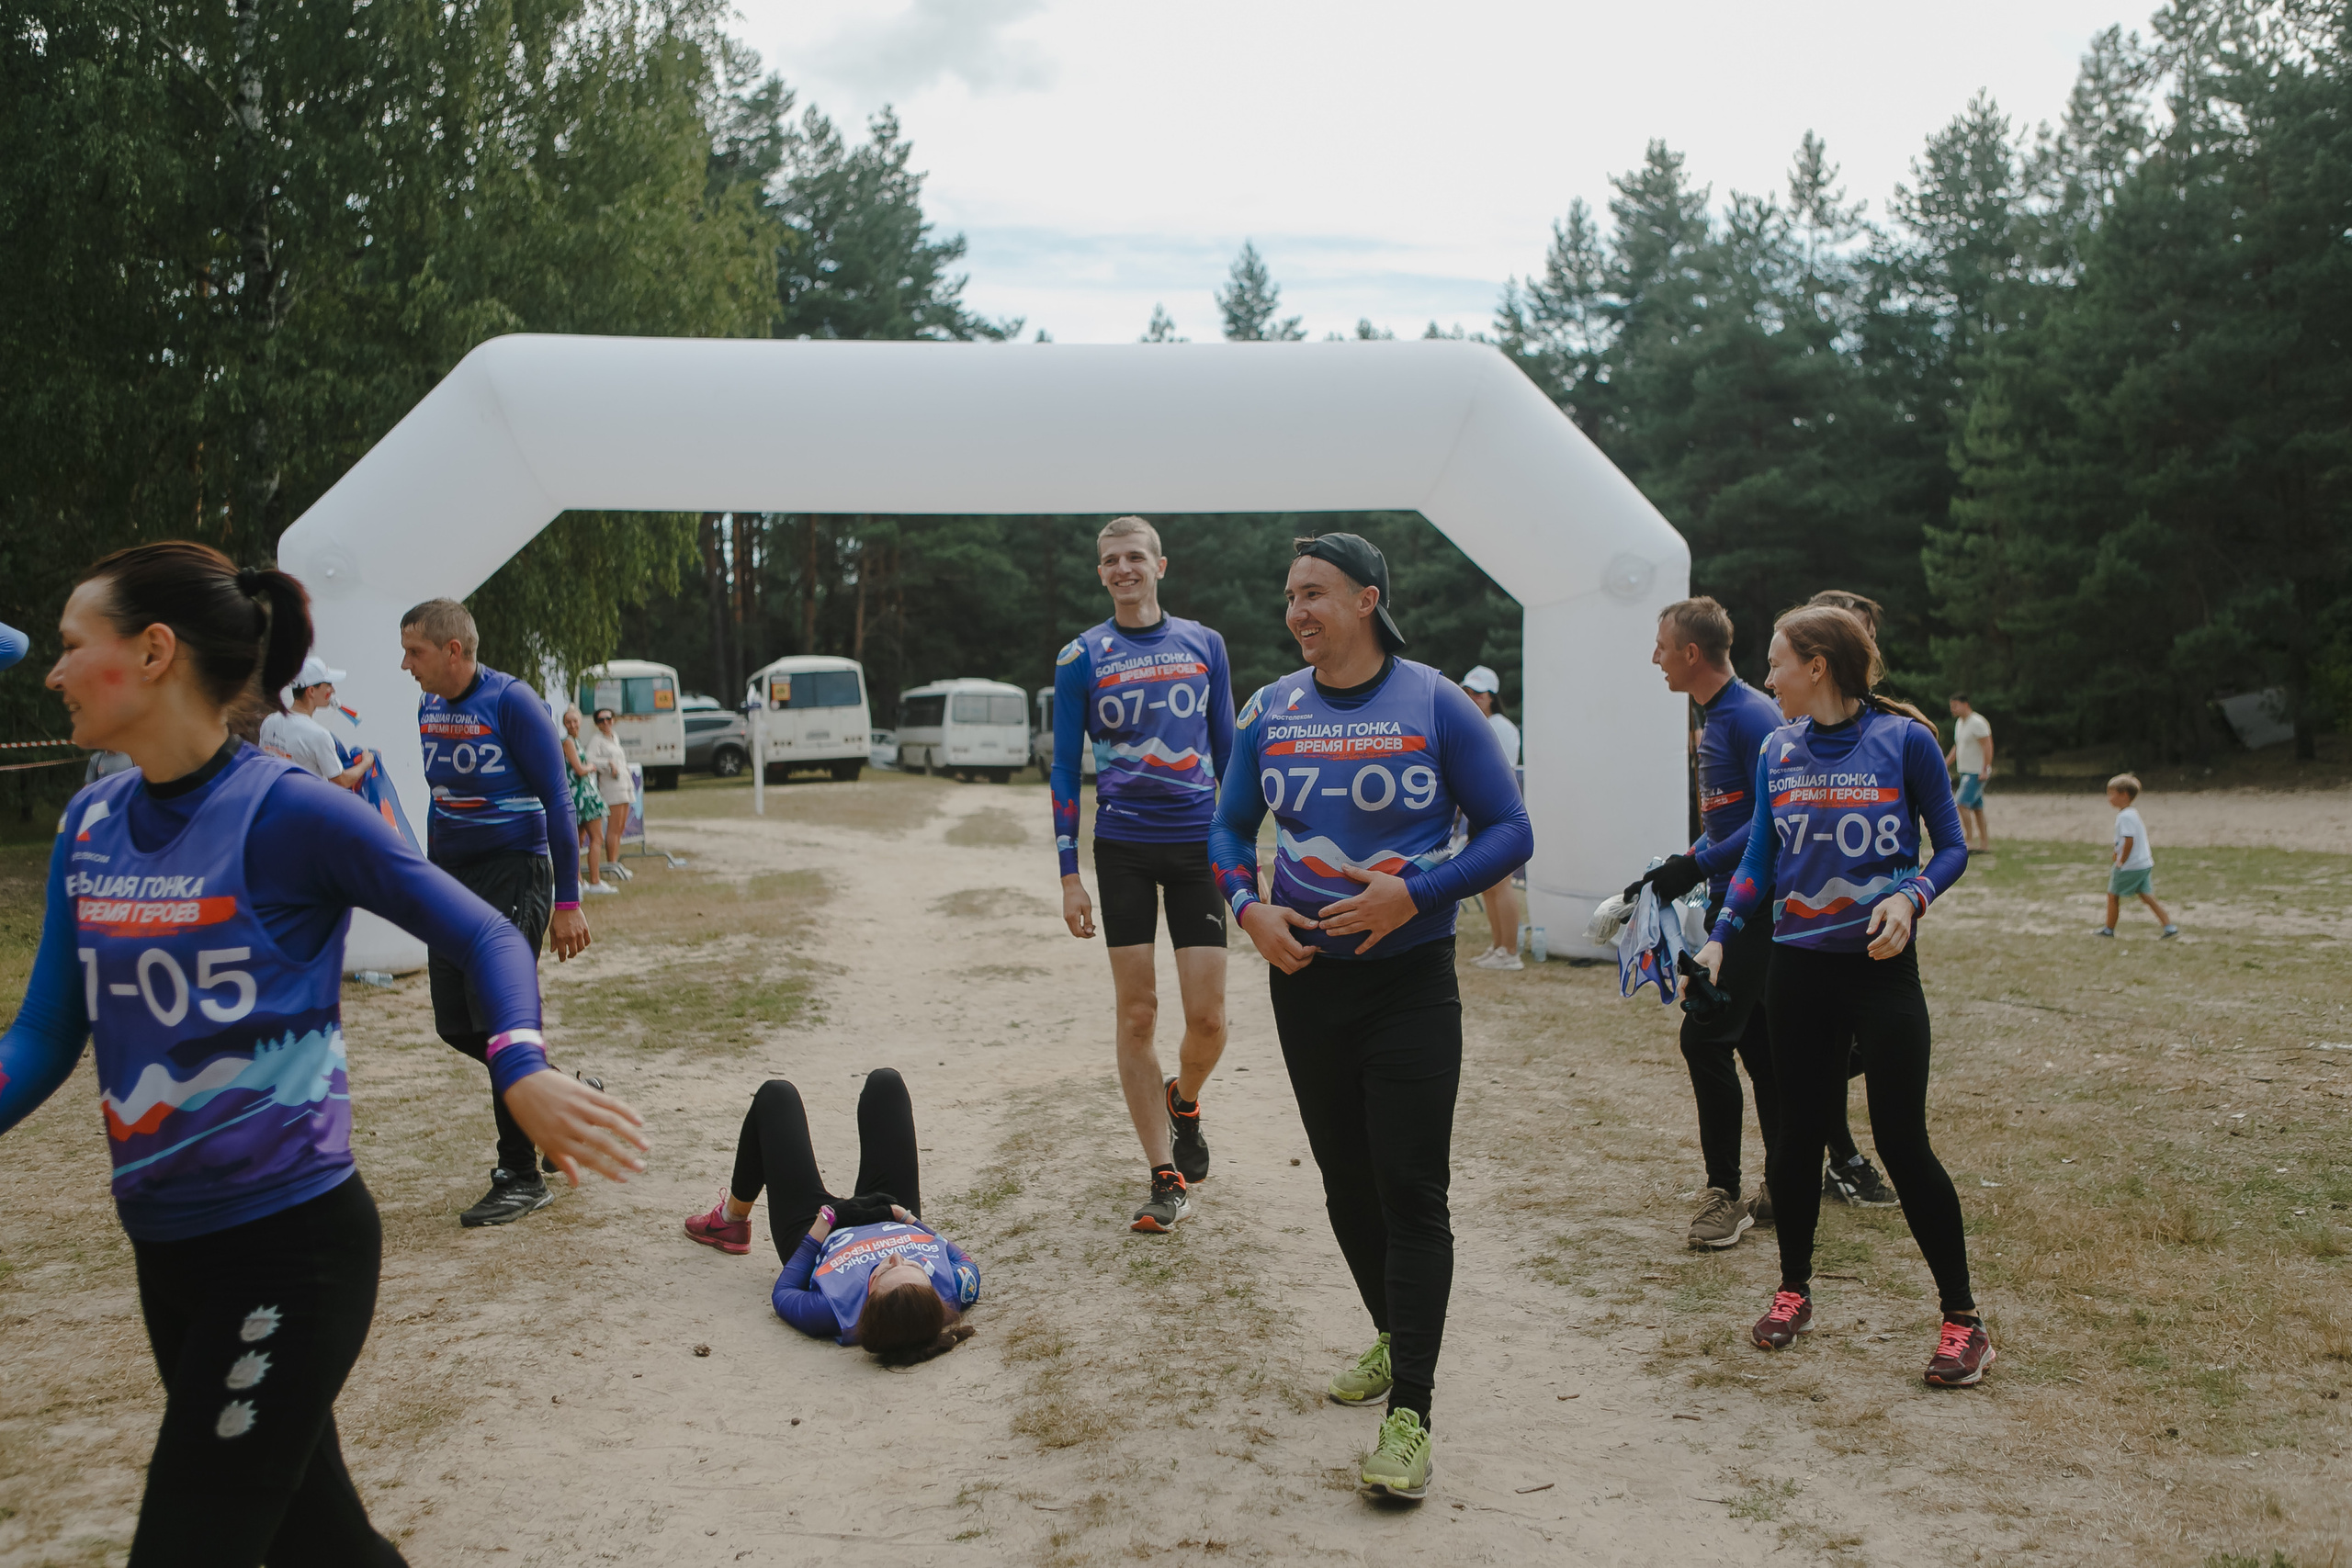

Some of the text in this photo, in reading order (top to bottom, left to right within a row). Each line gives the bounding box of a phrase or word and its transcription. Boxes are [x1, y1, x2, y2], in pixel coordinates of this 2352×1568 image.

[1095, 652, 1194, 678] БОЛЬШАЯ ГОНКА
[1120, 664, 1198, 682] ВРЕМЯ ГЕРОЕВ
[1098, 682, 1210, 729] 07-04
[451, 713, 480, 725] ГОНКА
[1272, 713, 1313, 721] Ростелеком
[427, 724, 481, 735] ВРЕМЯ ГЕРОЕВ
[1267, 721, 1402, 739] БОЛЬШАЯ ГОНКА
[1295, 738, 1403, 753] ВРЕМЯ ГЕРОЕВ
[424, 741, 505, 773] 7-02
[1261, 764, 1437, 812] 07-09
[1769, 773, 1878, 793] БОЛЬШАЯ ГОНКА
[1789, 788, 1880, 802] ВРЕМЯ ГЕРОЕВ
[138, 874, 205, 897] ГОНКА
[131, 901, 200, 923] ГЕРОЕВ
[78, 946, 257, 1028] 7-05
[872, 1234, 911, 1247] ВРЕМЯ
[829, 1245, 872, 1269] ГЕРОЕВ
[834, 1242, 940, 1274] БОЛЬШАЯ ГОНКА
